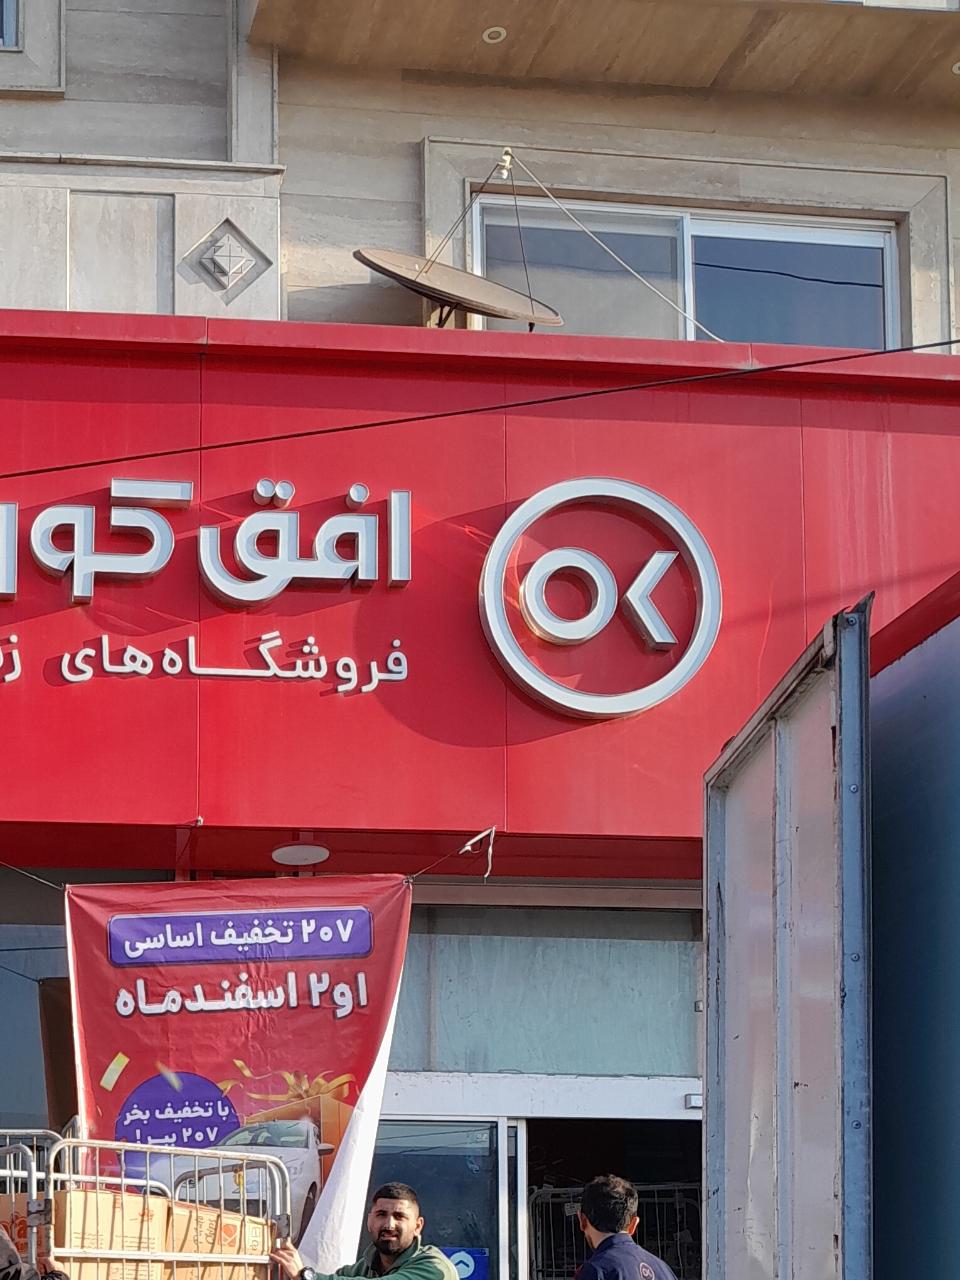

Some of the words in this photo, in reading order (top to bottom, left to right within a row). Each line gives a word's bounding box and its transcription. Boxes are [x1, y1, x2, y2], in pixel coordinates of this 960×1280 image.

[198, 477, 412, 606] افق
[123, 922, 203, 958] اساسی
[210, 920, 294, 952] تخفیف
[301, 918, 355, 944] ۲۰۷
[115, 971, 298, 1017] اسفندماه
[123, 1103, 151, 1126] بخر
[154, 1101, 214, 1123] تخفیف
[217, 1100, 230, 1120] با
[182, 1126, 219, 1143] ۲۰۷
